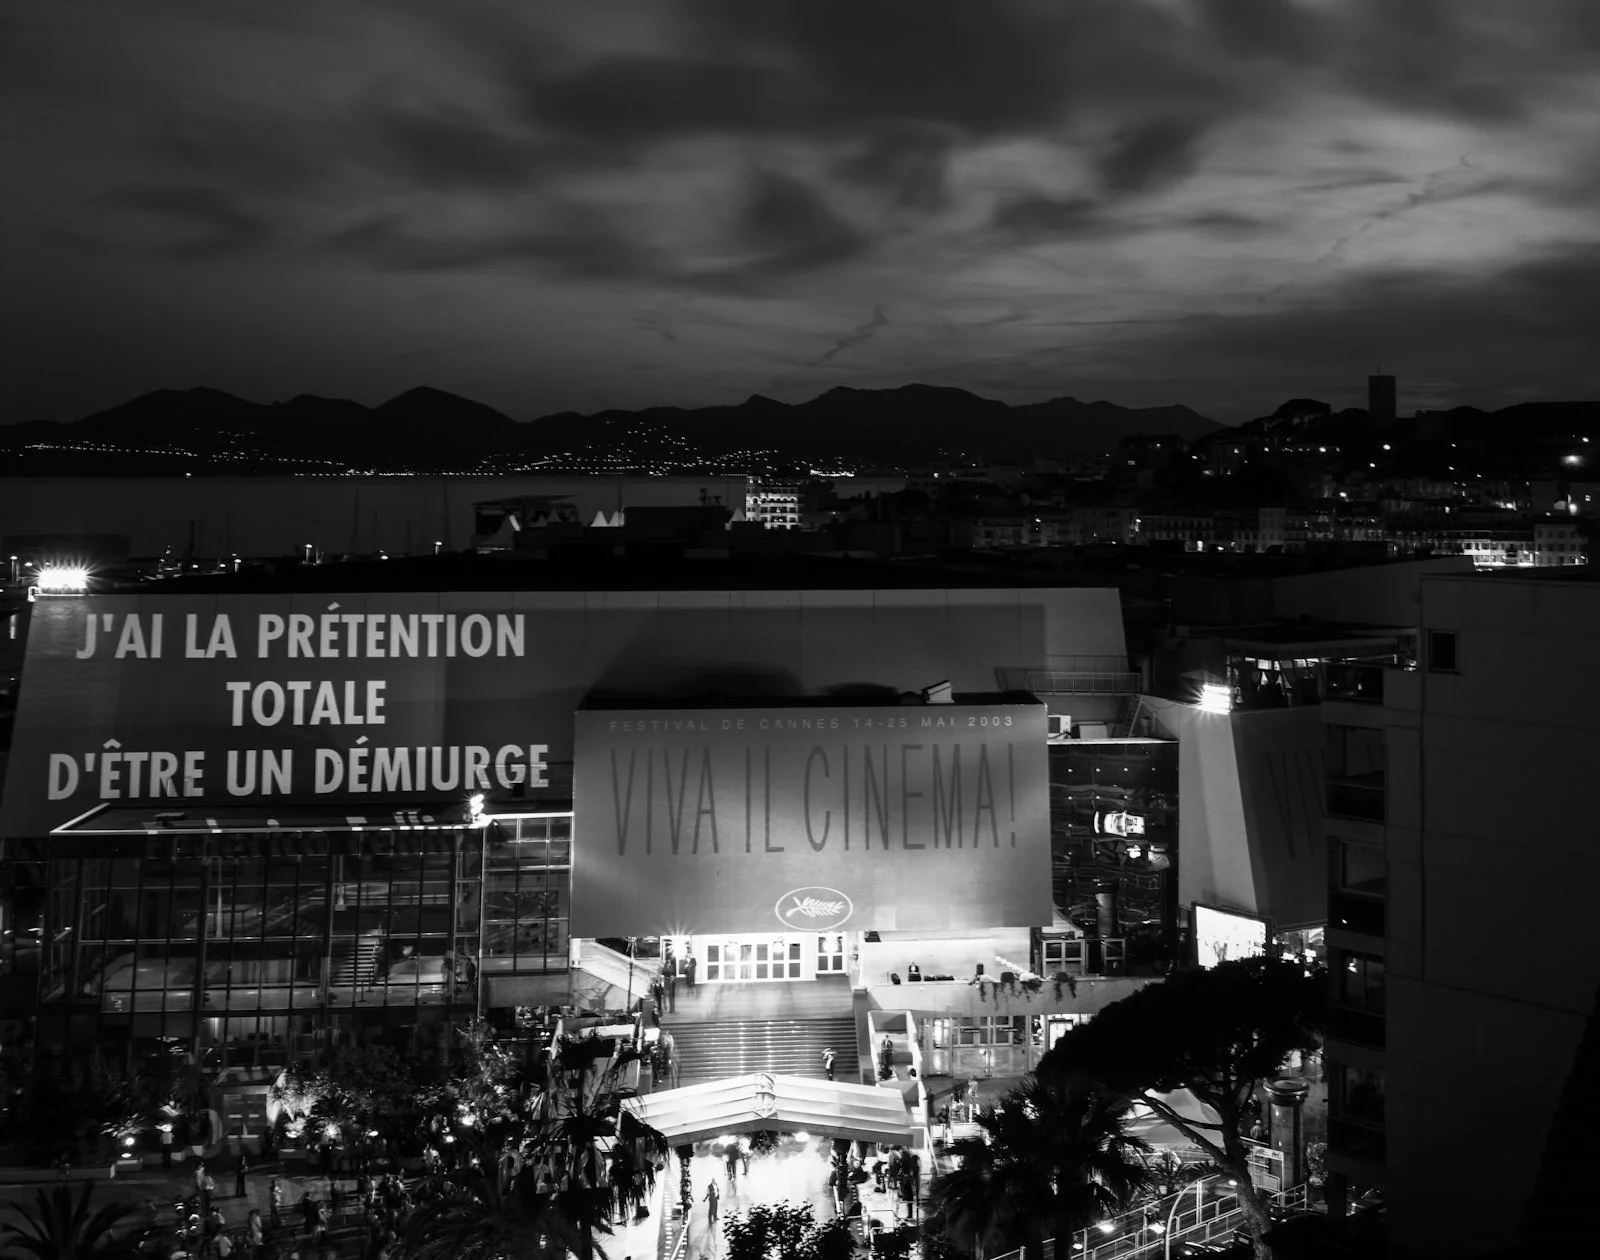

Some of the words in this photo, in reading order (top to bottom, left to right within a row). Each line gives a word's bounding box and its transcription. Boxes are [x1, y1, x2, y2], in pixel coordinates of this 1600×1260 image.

[76, 612, 163, 660] J'AI
[185, 613, 238, 659] LA
[257, 602, 525, 659] PRÉTENTION
[226, 680, 386, 727] TOTALE
[609, 719, 707, 732] FESTIVAL
[722, 718, 746, 731] DE
[759, 717, 839, 730] CANNES
[921, 716, 956, 728] MAI
[968, 715, 1014, 727] 2003
[48, 738, 206, 801] D'ÊTRE
[226, 749, 292, 796] UN
[314, 735, 549, 794] DÉMIURGE
[610, 746, 719, 856] VIVA
[745, 745, 785, 854] IL
[803, 742, 1016, 852] CINEMA!
